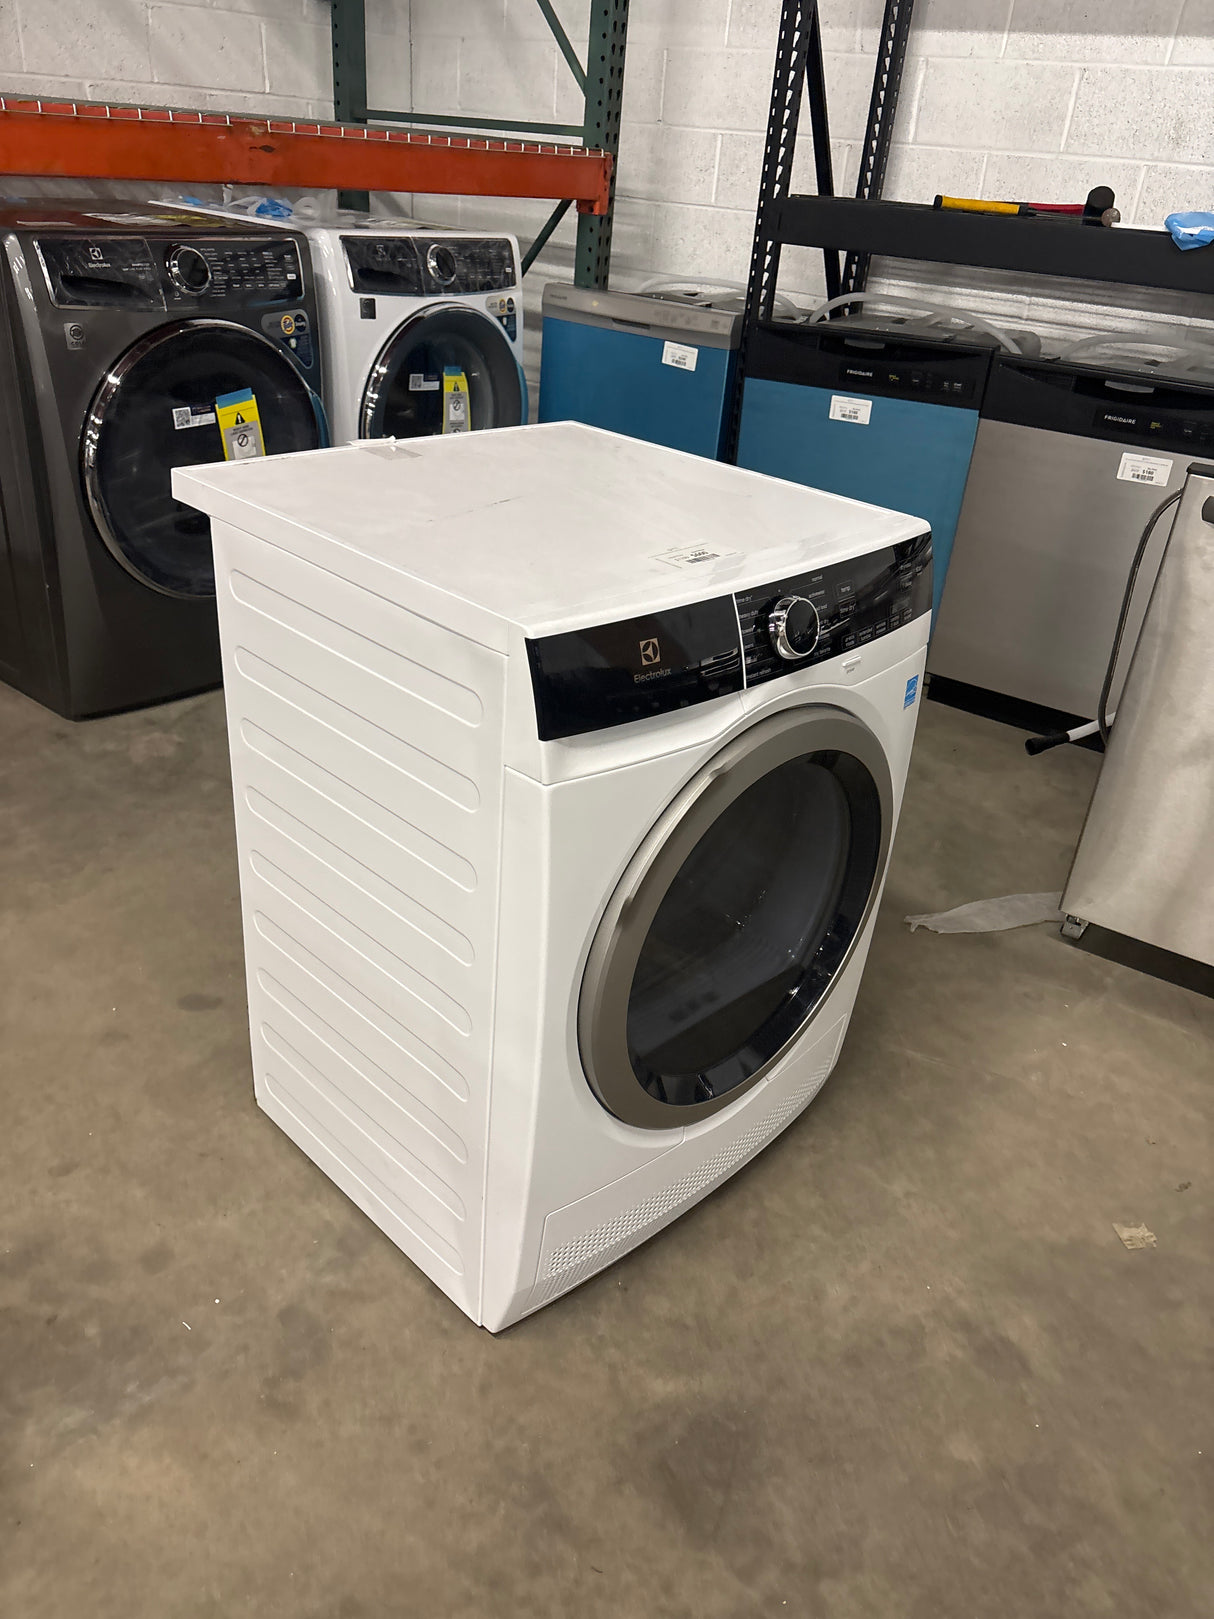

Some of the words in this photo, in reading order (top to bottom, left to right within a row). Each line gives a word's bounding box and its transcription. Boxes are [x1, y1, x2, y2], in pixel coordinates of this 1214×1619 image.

[846, 368, 873, 378] FRIGIDAIRE
[1103, 414, 1136, 425] FRIGIDAIRE
[633, 668, 672, 684] Electrolux
